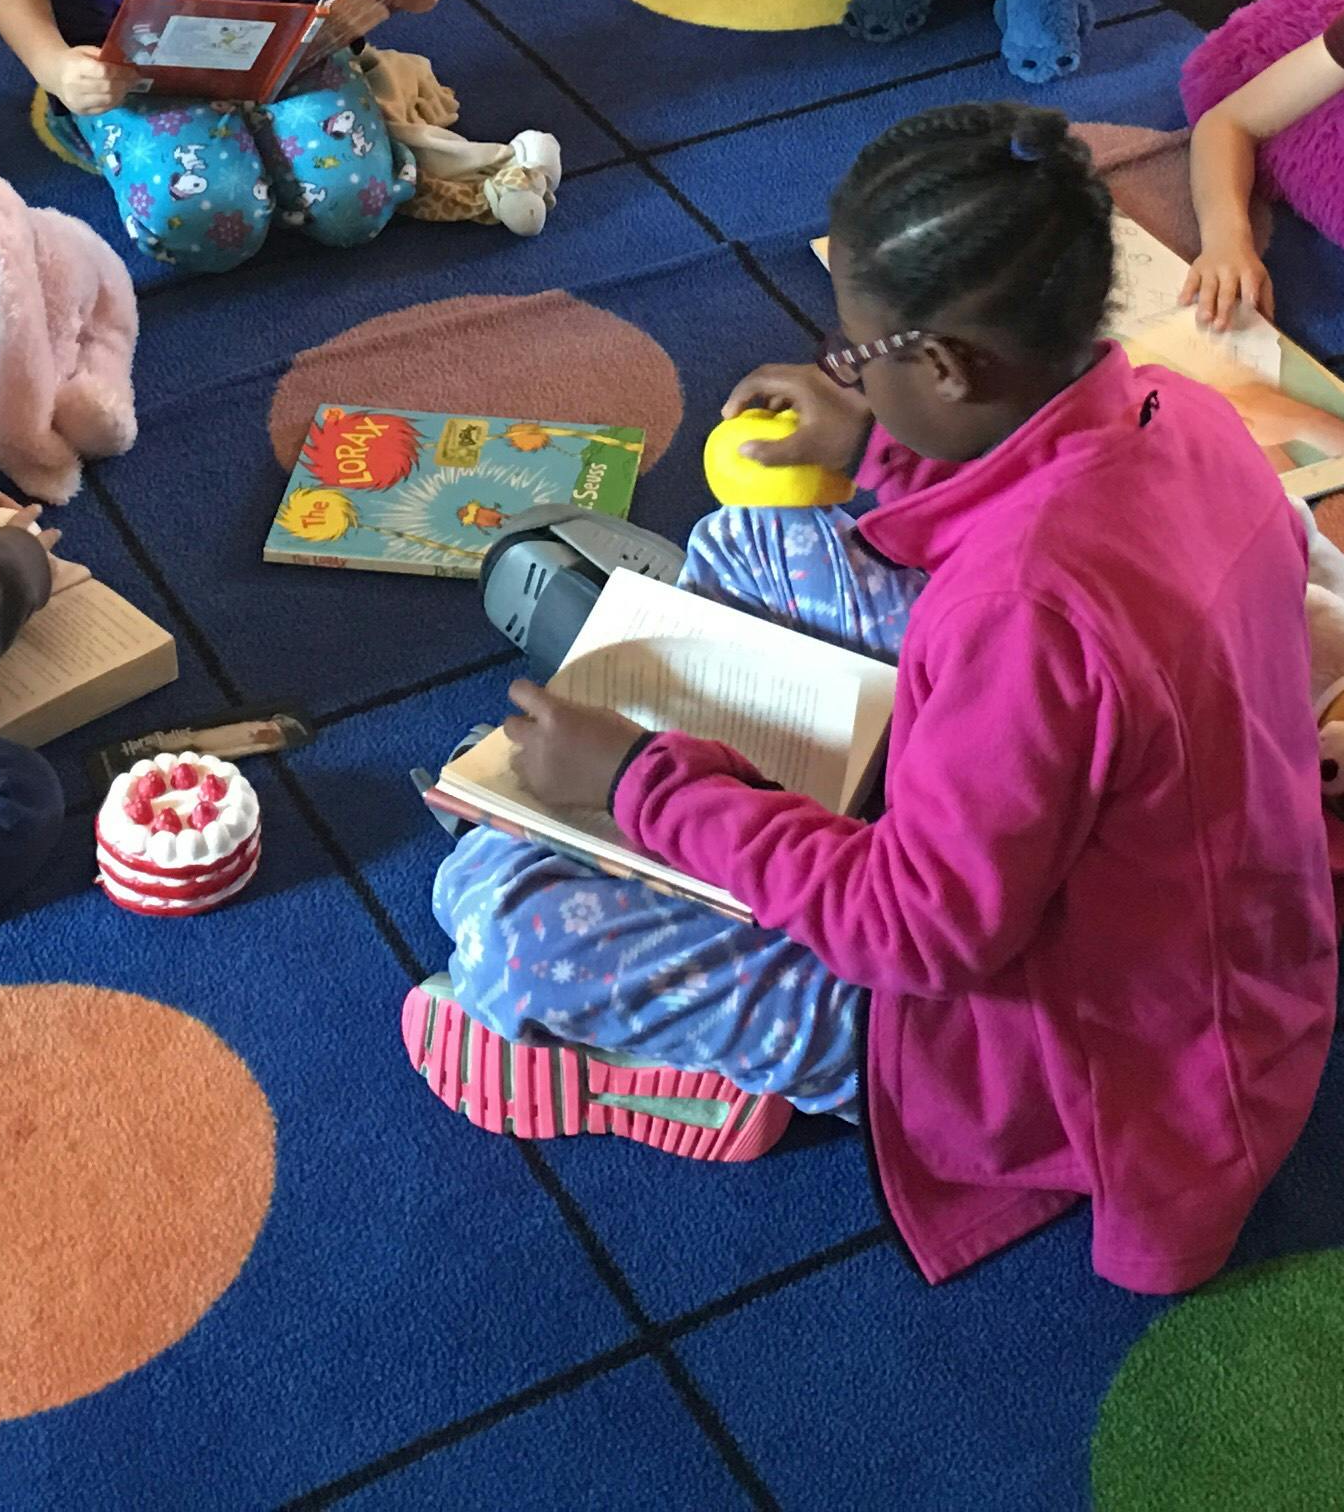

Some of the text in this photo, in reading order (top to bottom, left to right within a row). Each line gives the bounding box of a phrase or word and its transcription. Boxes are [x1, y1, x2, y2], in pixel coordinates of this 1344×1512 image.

[335, 416, 390, 486] LORAX
[572, 461, 608, 502] Seuss
[301, 499, 330, 529] The
